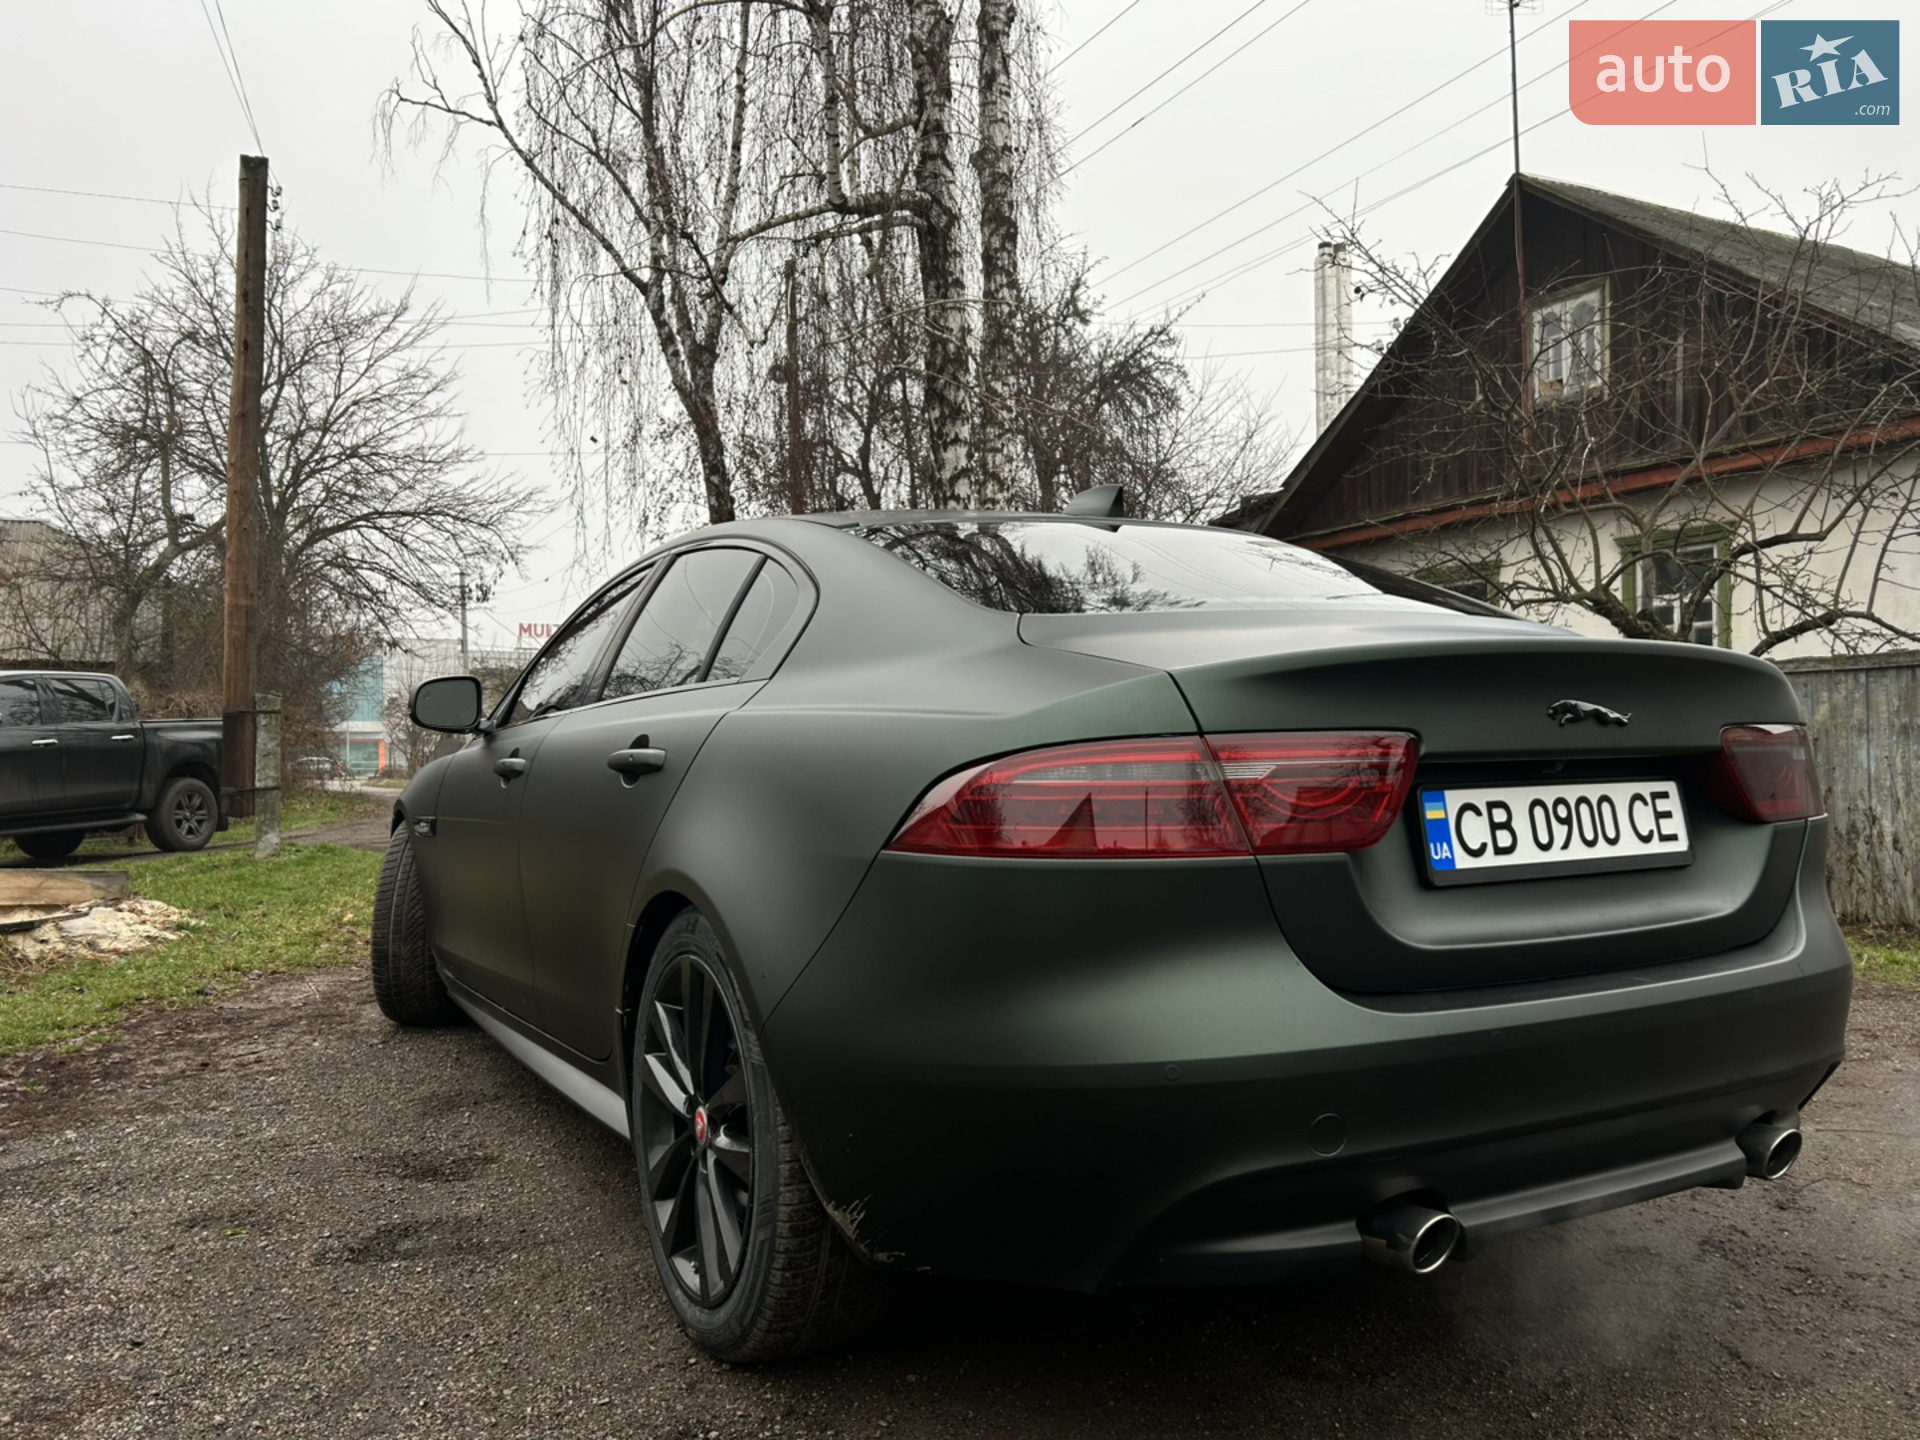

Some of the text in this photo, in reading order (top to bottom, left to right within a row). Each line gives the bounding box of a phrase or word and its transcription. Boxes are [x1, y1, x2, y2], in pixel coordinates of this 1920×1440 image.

[1455, 791, 1679, 858] CB 0900 CE
[1430, 842, 1452, 860] UA
